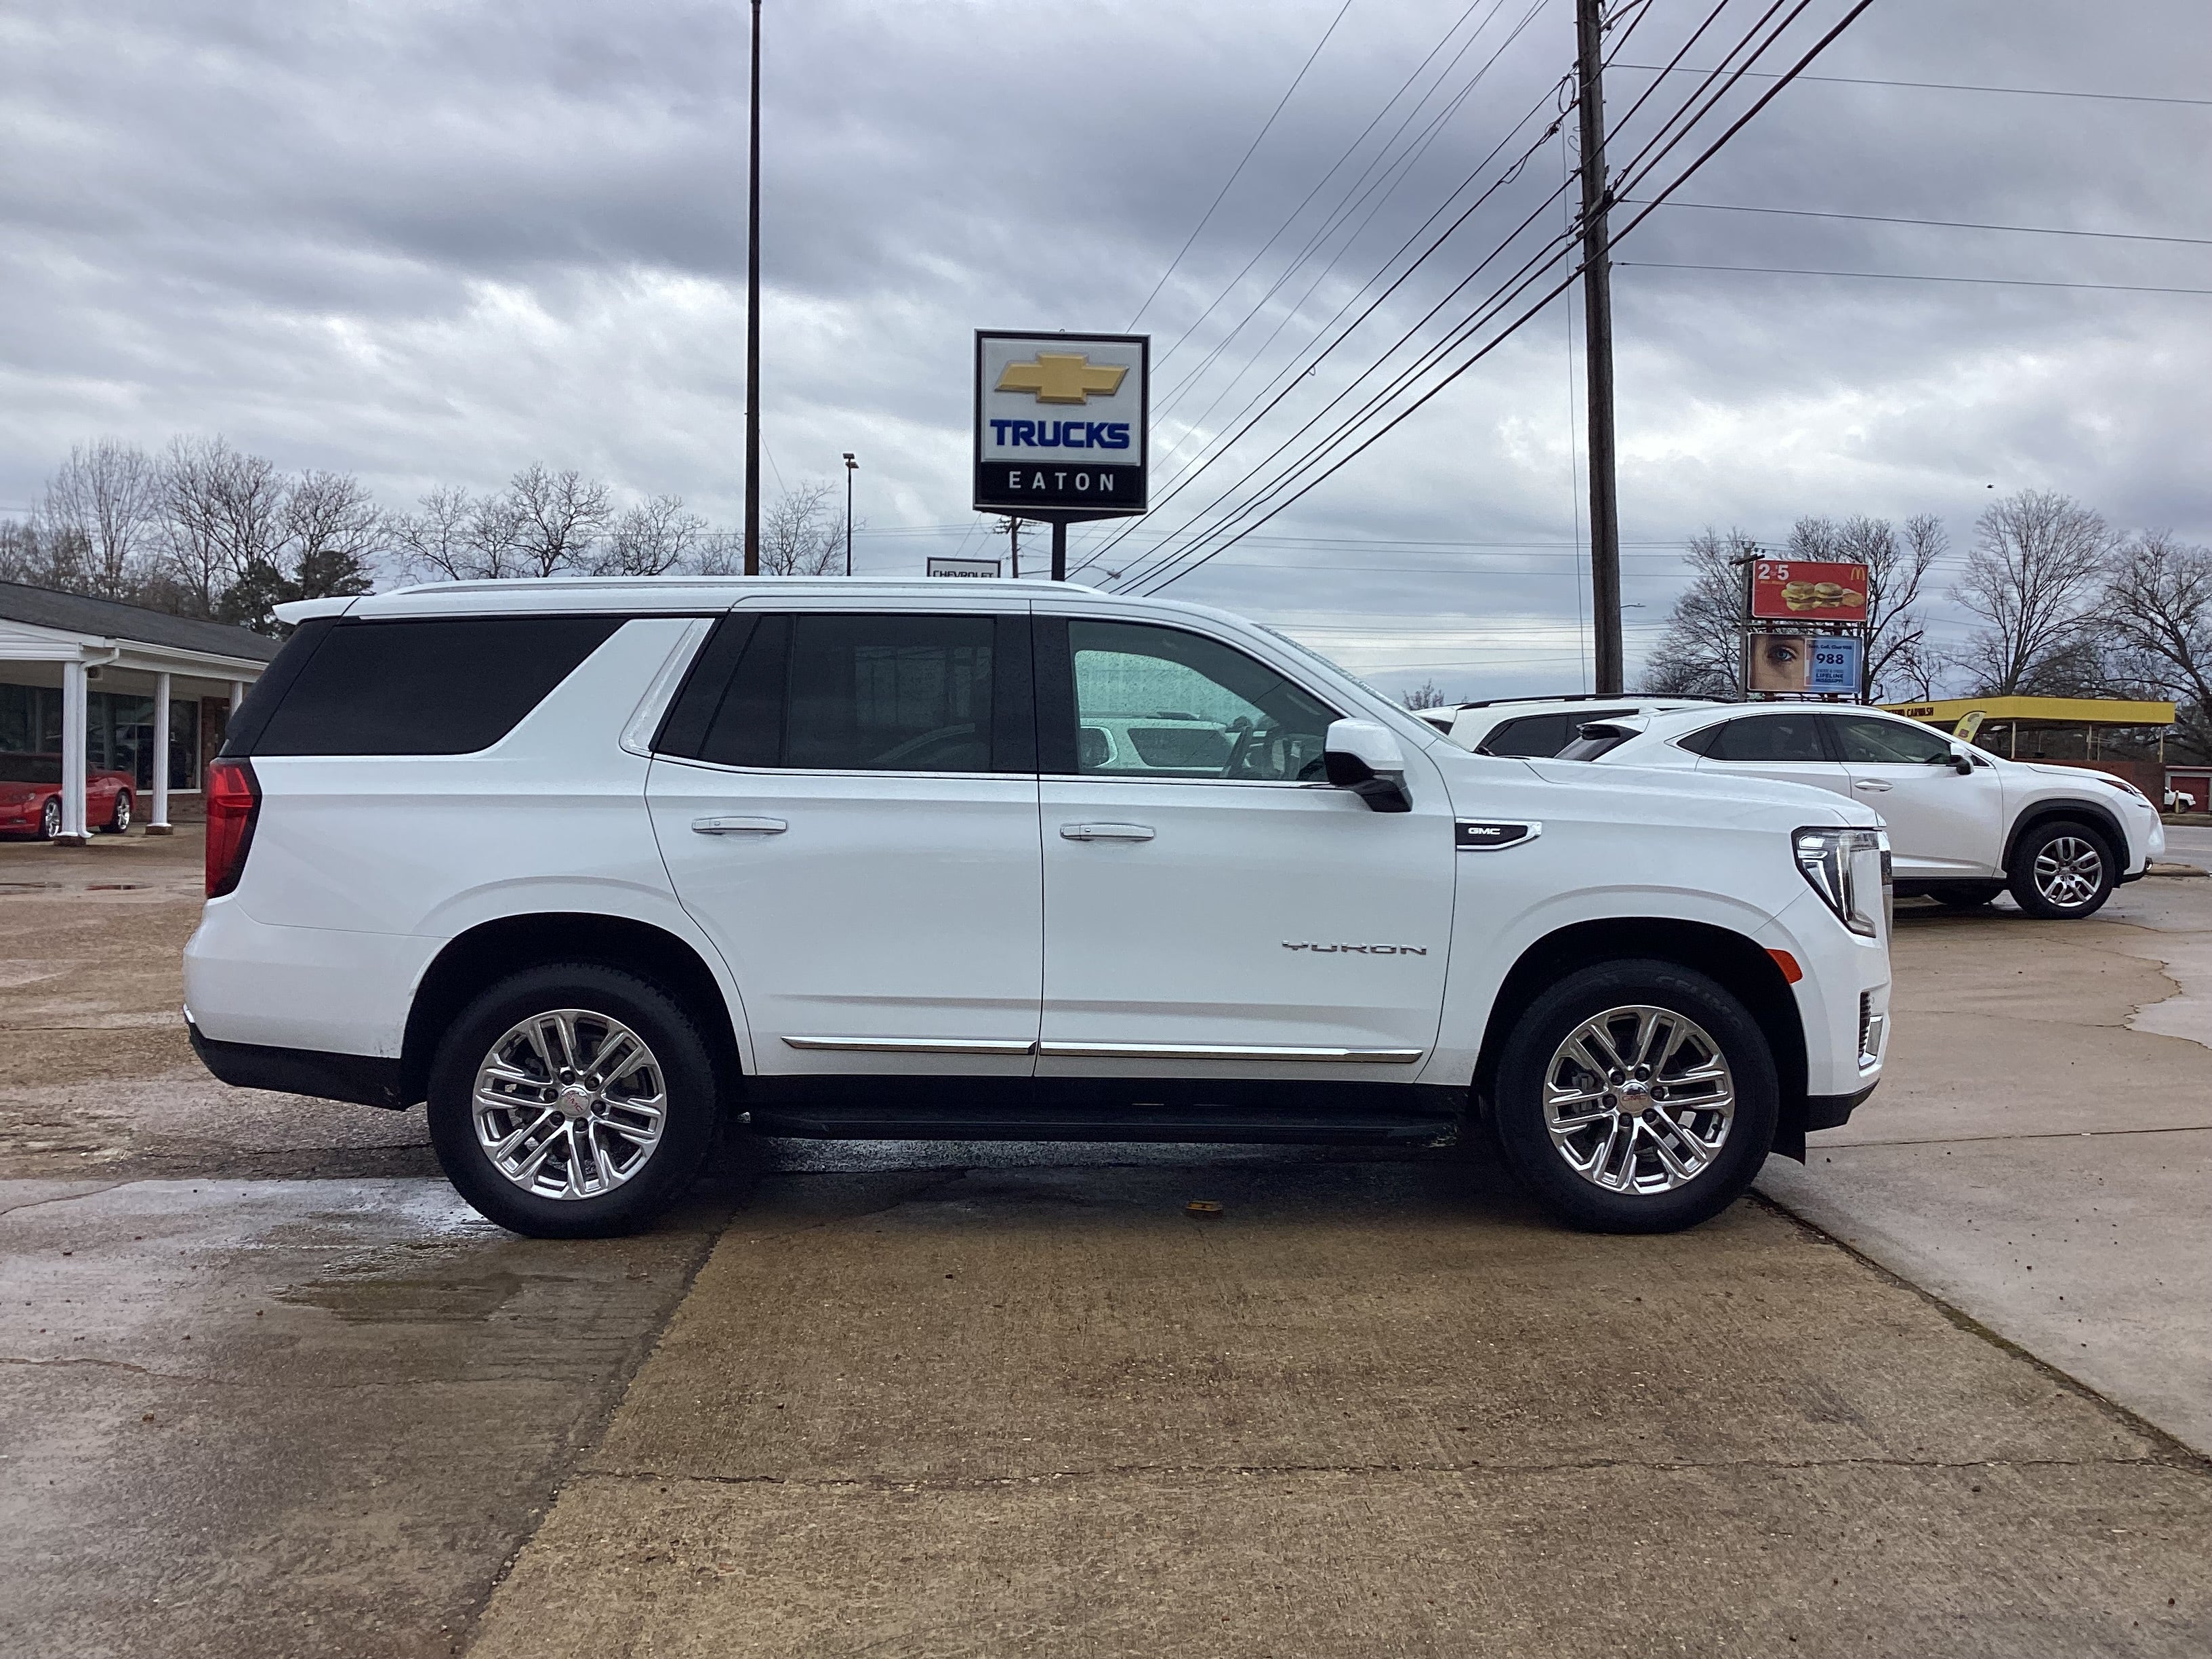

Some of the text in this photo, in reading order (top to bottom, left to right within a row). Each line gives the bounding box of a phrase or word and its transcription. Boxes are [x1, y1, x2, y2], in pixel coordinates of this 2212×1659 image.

[990, 419, 1130, 449] TRUCKS
[1008, 471, 1113, 491] EATON
[1758, 563, 1770, 579] 2
[1816, 653, 1844, 665] 988
[1282, 940, 1427, 956] YUKON
